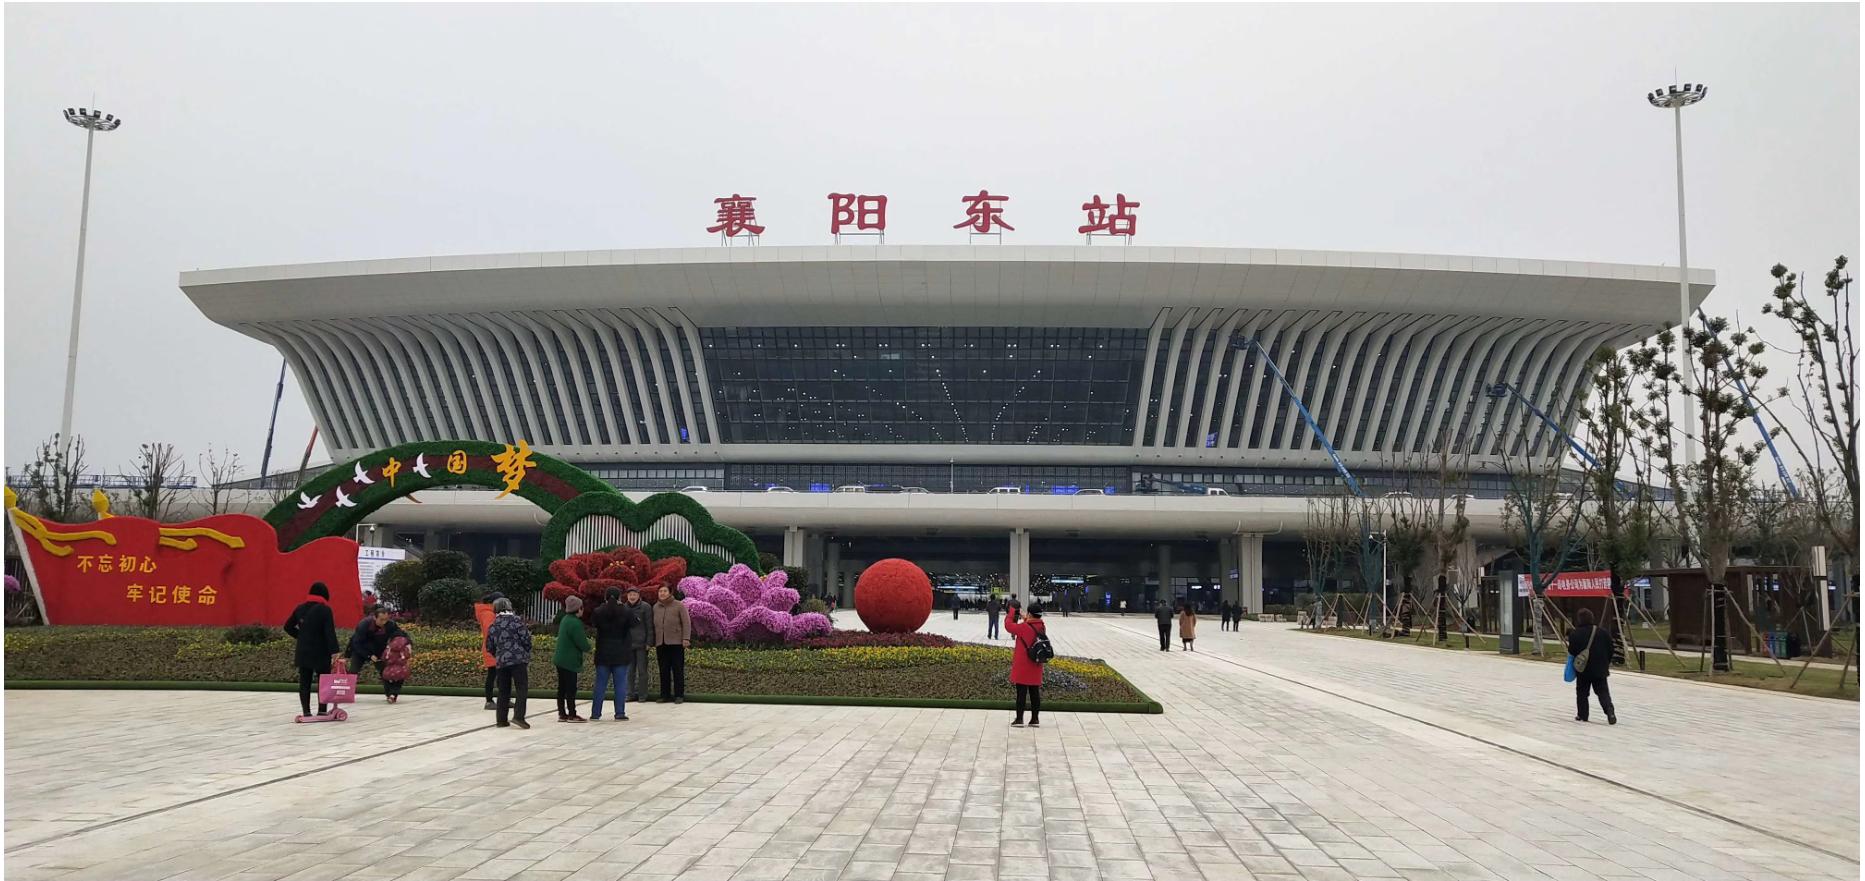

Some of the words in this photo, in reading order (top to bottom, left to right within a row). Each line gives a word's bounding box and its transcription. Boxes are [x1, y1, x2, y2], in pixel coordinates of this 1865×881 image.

[706, 190, 1140, 236] 襄阳东站
[382, 439, 537, 498] 中国梦
[76, 554, 158, 573] 不忘初心
[127, 584, 218, 605] 牢记使命
